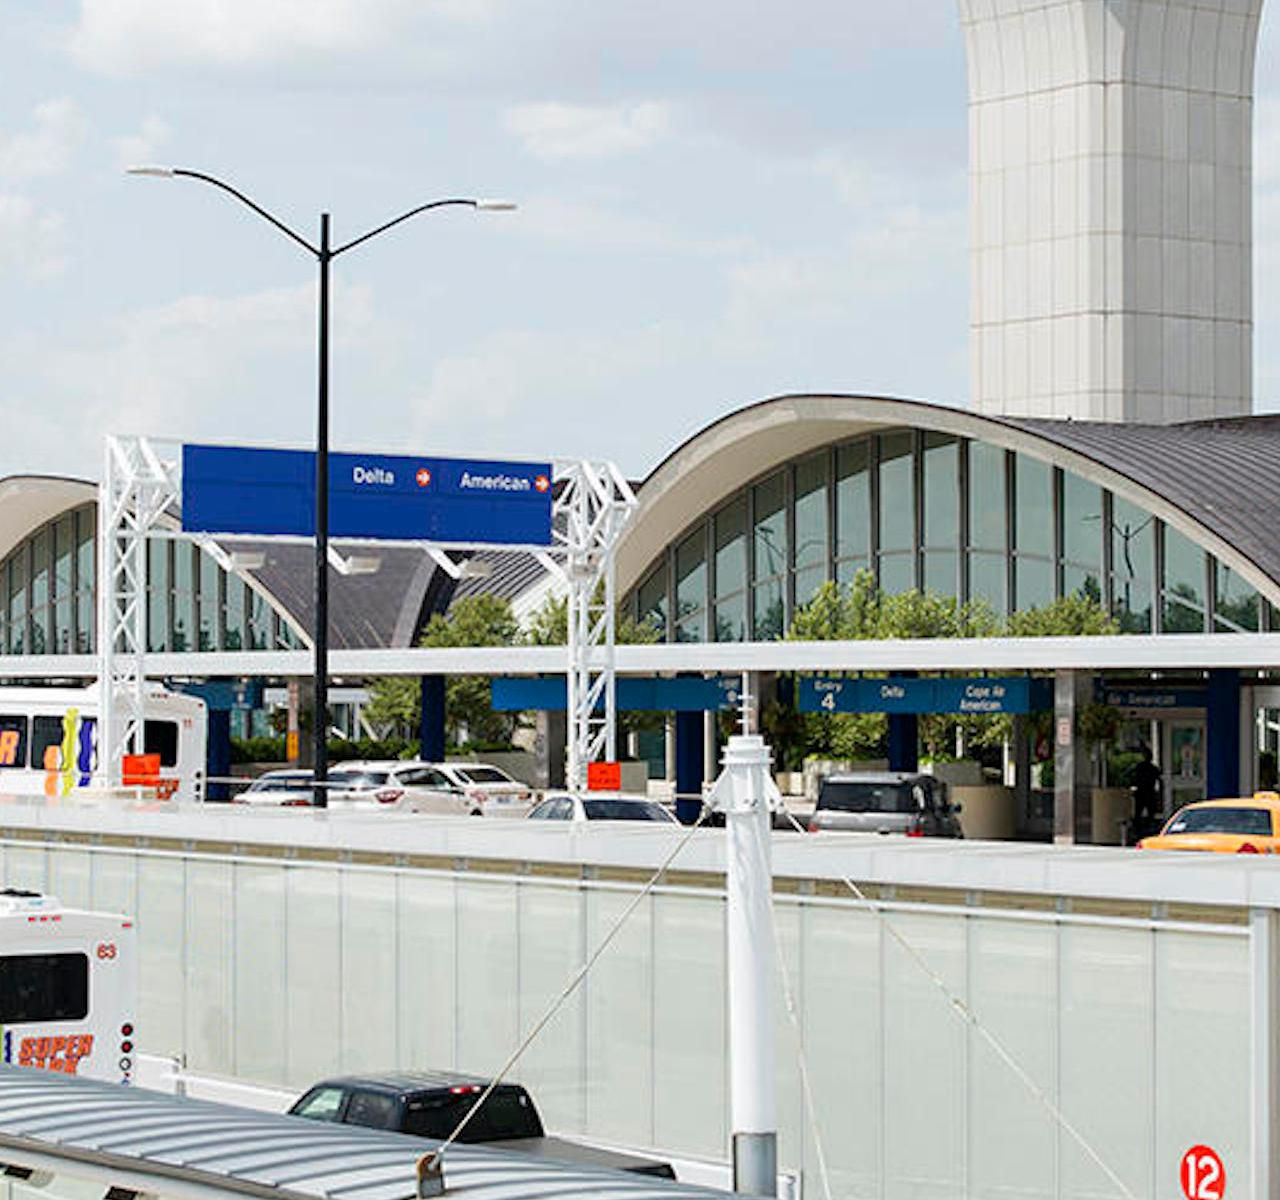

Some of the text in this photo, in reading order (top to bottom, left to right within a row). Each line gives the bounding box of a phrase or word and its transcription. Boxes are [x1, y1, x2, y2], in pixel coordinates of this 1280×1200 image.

[353, 466, 394, 485] Delta
[460, 472, 530, 491] American
[821, 692, 836, 710] 4
[96, 943, 117, 960] 63
[19, 1034, 94, 1063] SUPER
[1186, 1153, 1220, 1199] 12
